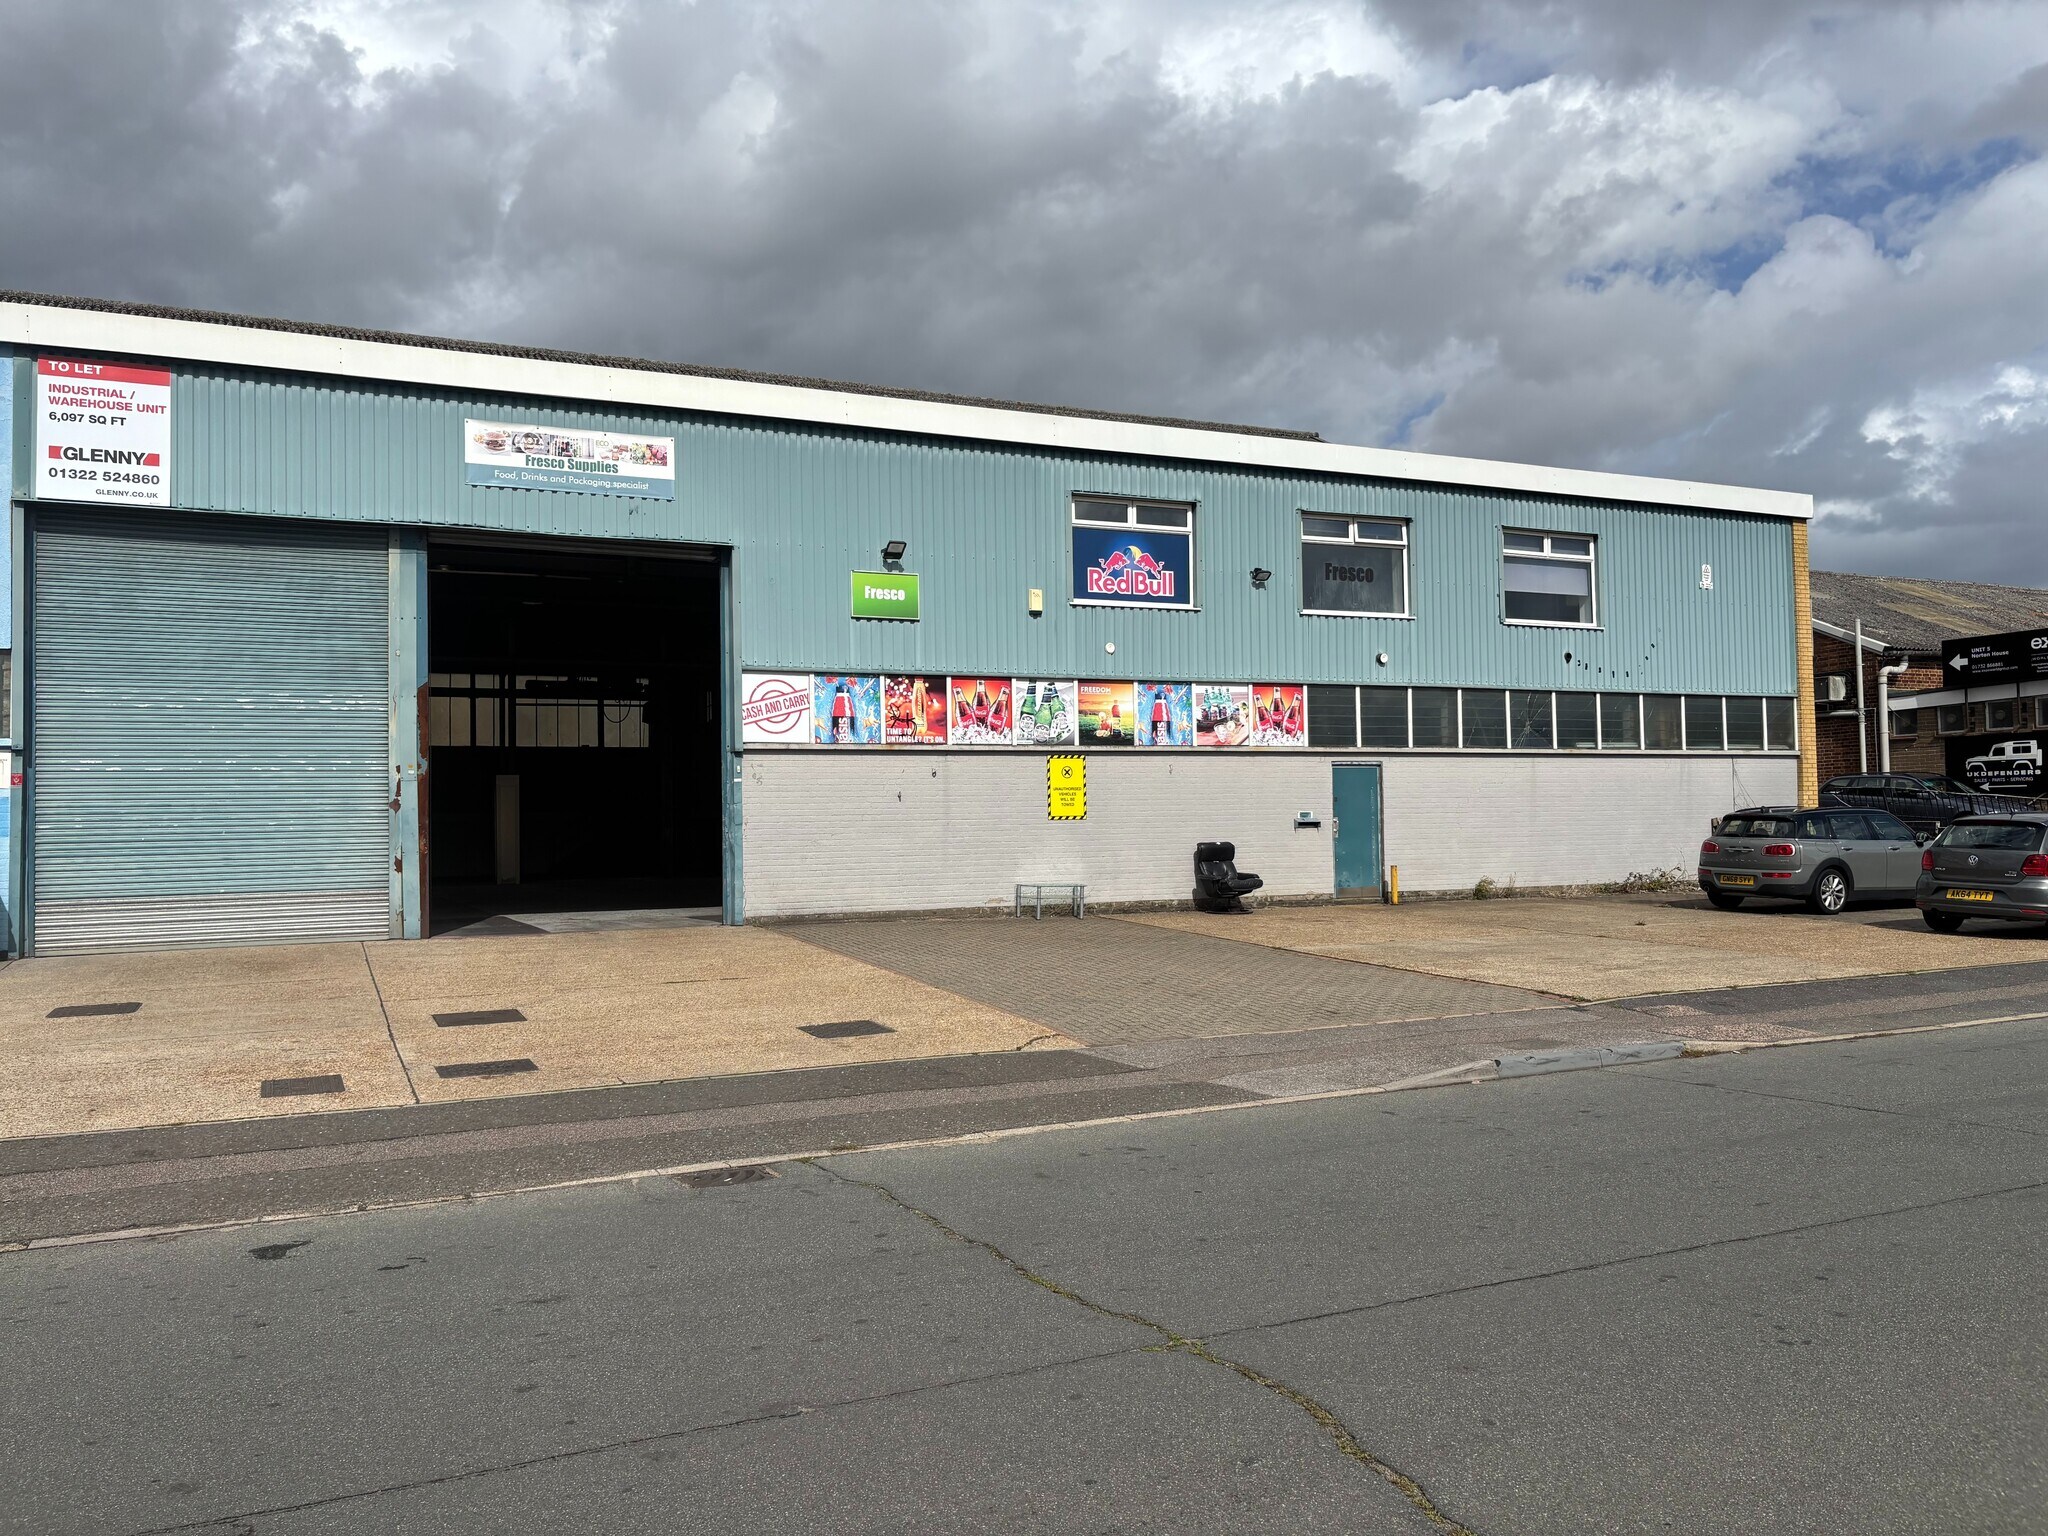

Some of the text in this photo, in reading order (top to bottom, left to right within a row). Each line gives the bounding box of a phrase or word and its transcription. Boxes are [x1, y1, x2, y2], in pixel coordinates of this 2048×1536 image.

[48, 360, 103, 375] TO LET
[48, 384, 135, 399] INDUSTRIAL /
[48, 396, 166, 414] WAREHOUSE UNIT
[48, 412, 126, 426] 6,097 SQ FT
[63, 446, 145, 465] GLENNY
[525, 455, 618, 474] Fresco Supplies
[48, 467, 160, 485] 01322 524860
[494, 470, 649, 490] Food, Drinks and Packaging specialist
[96, 489, 158, 498] GLENNY.CO.UK
[1087, 566, 1175, 597] Red Bull
[1324, 562, 1374, 584] Fresco
[864, 585, 906, 601] Fresco
[742, 693, 810, 720] CASH AND CARRY
[887, 735, 922, 743] UNTANGLE?
[1950, 890, 1990, 899] AK64 TYT
